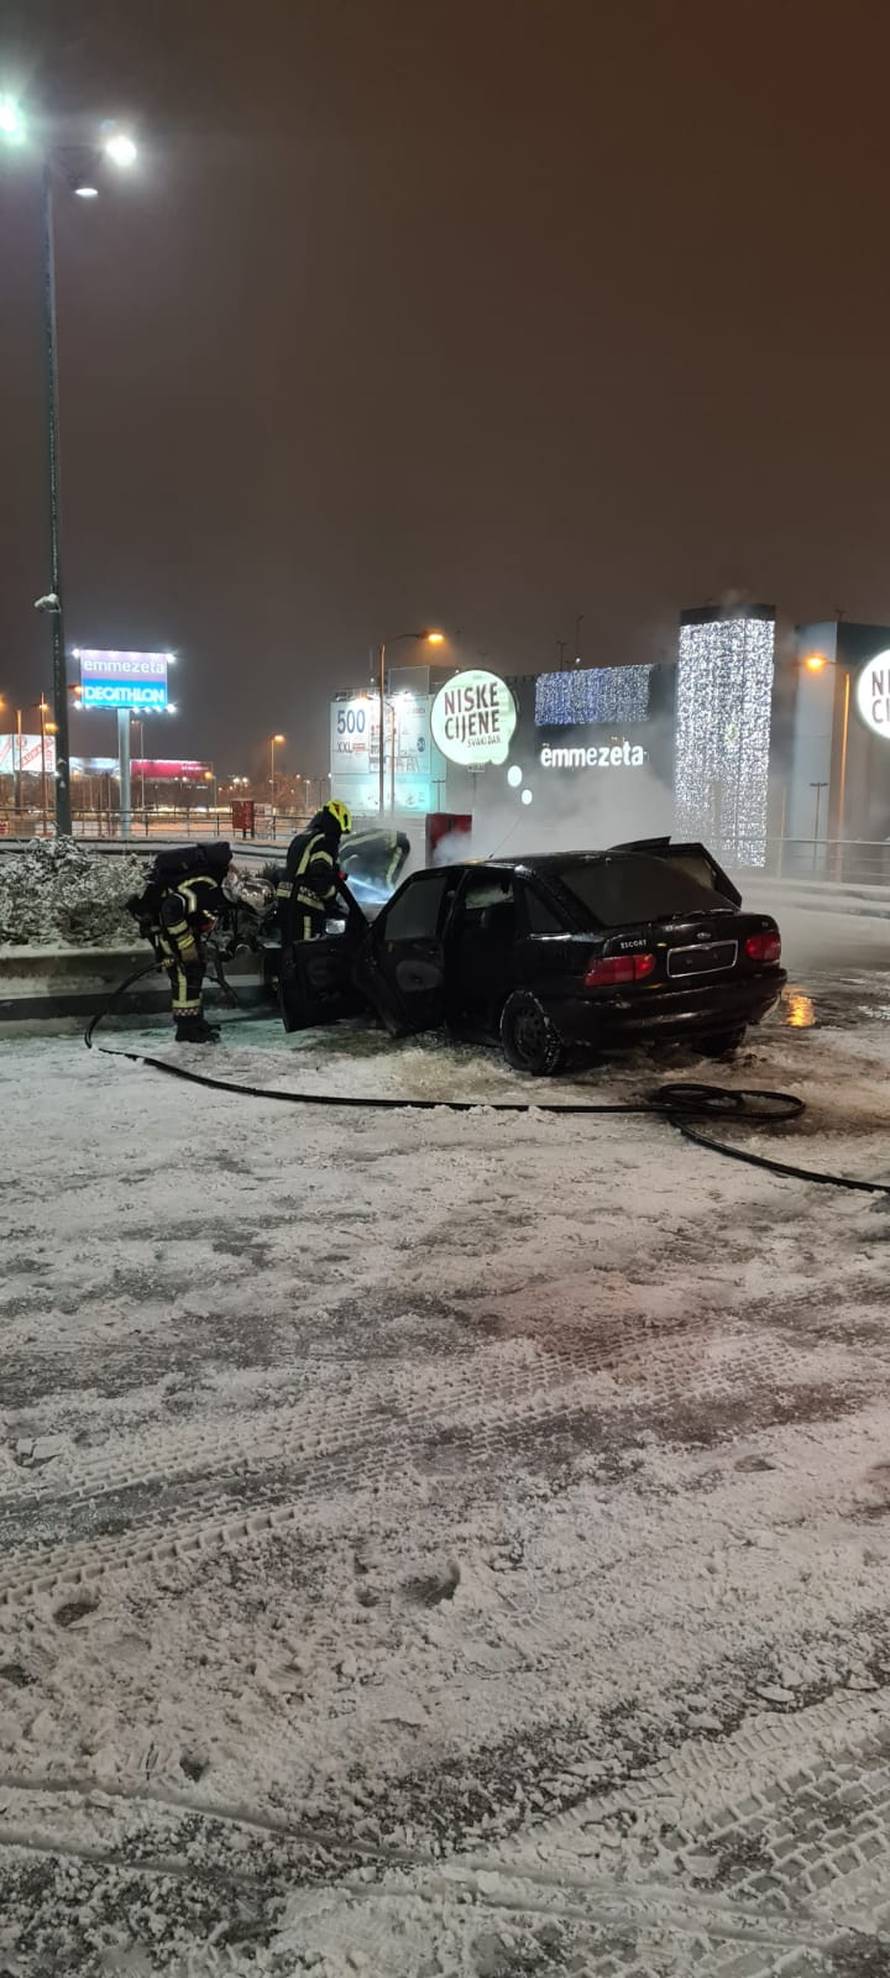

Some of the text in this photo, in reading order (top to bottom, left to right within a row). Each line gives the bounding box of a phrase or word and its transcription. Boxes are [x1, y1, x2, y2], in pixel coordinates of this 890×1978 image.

[84, 660, 165, 673] emmezeta
[85, 686, 165, 702] DECATHLON
[444, 681, 499, 716] NISKE
[336, 709, 366, 734] 500
[444, 709, 501, 742] CIJENE
[336, 741, 353, 753] XXL
[541, 741, 643, 767] emmezeta
